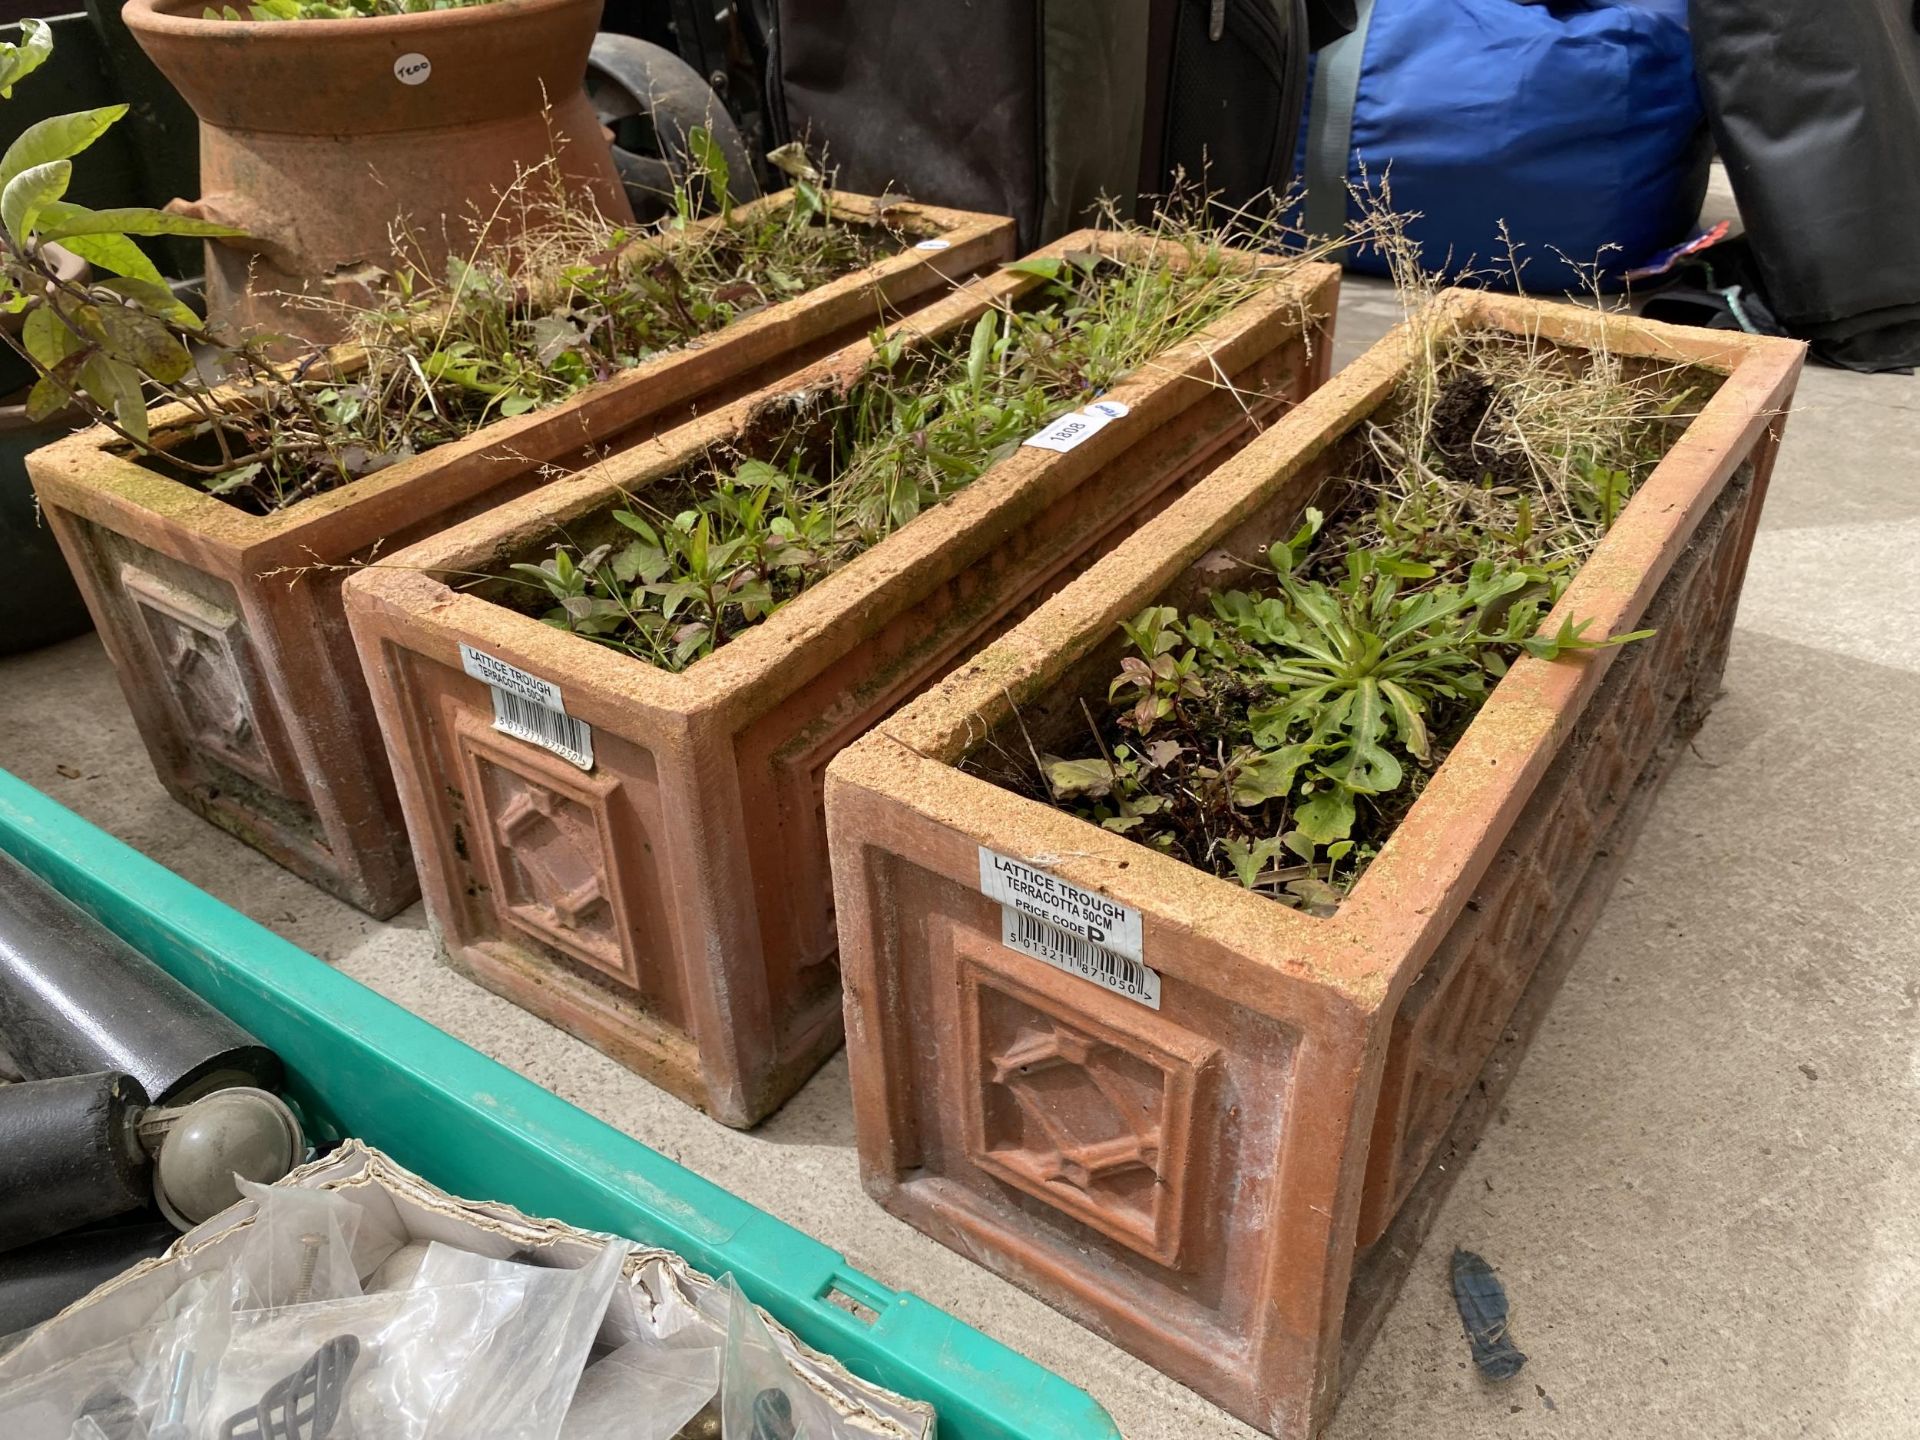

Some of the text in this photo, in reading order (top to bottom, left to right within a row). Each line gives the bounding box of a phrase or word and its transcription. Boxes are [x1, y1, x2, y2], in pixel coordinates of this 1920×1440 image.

[1050, 422, 1086, 442] 1808
[469, 649, 551, 697] LATTICE TROUGH
[478, 664, 526, 694] TERRACOTTA
[994, 856, 1125, 922] LATTICE TROUGH
[1006, 875, 1113, 931] TERRACOTTA 50CM
[1016, 898, 1106, 943] PRICE CODE P
